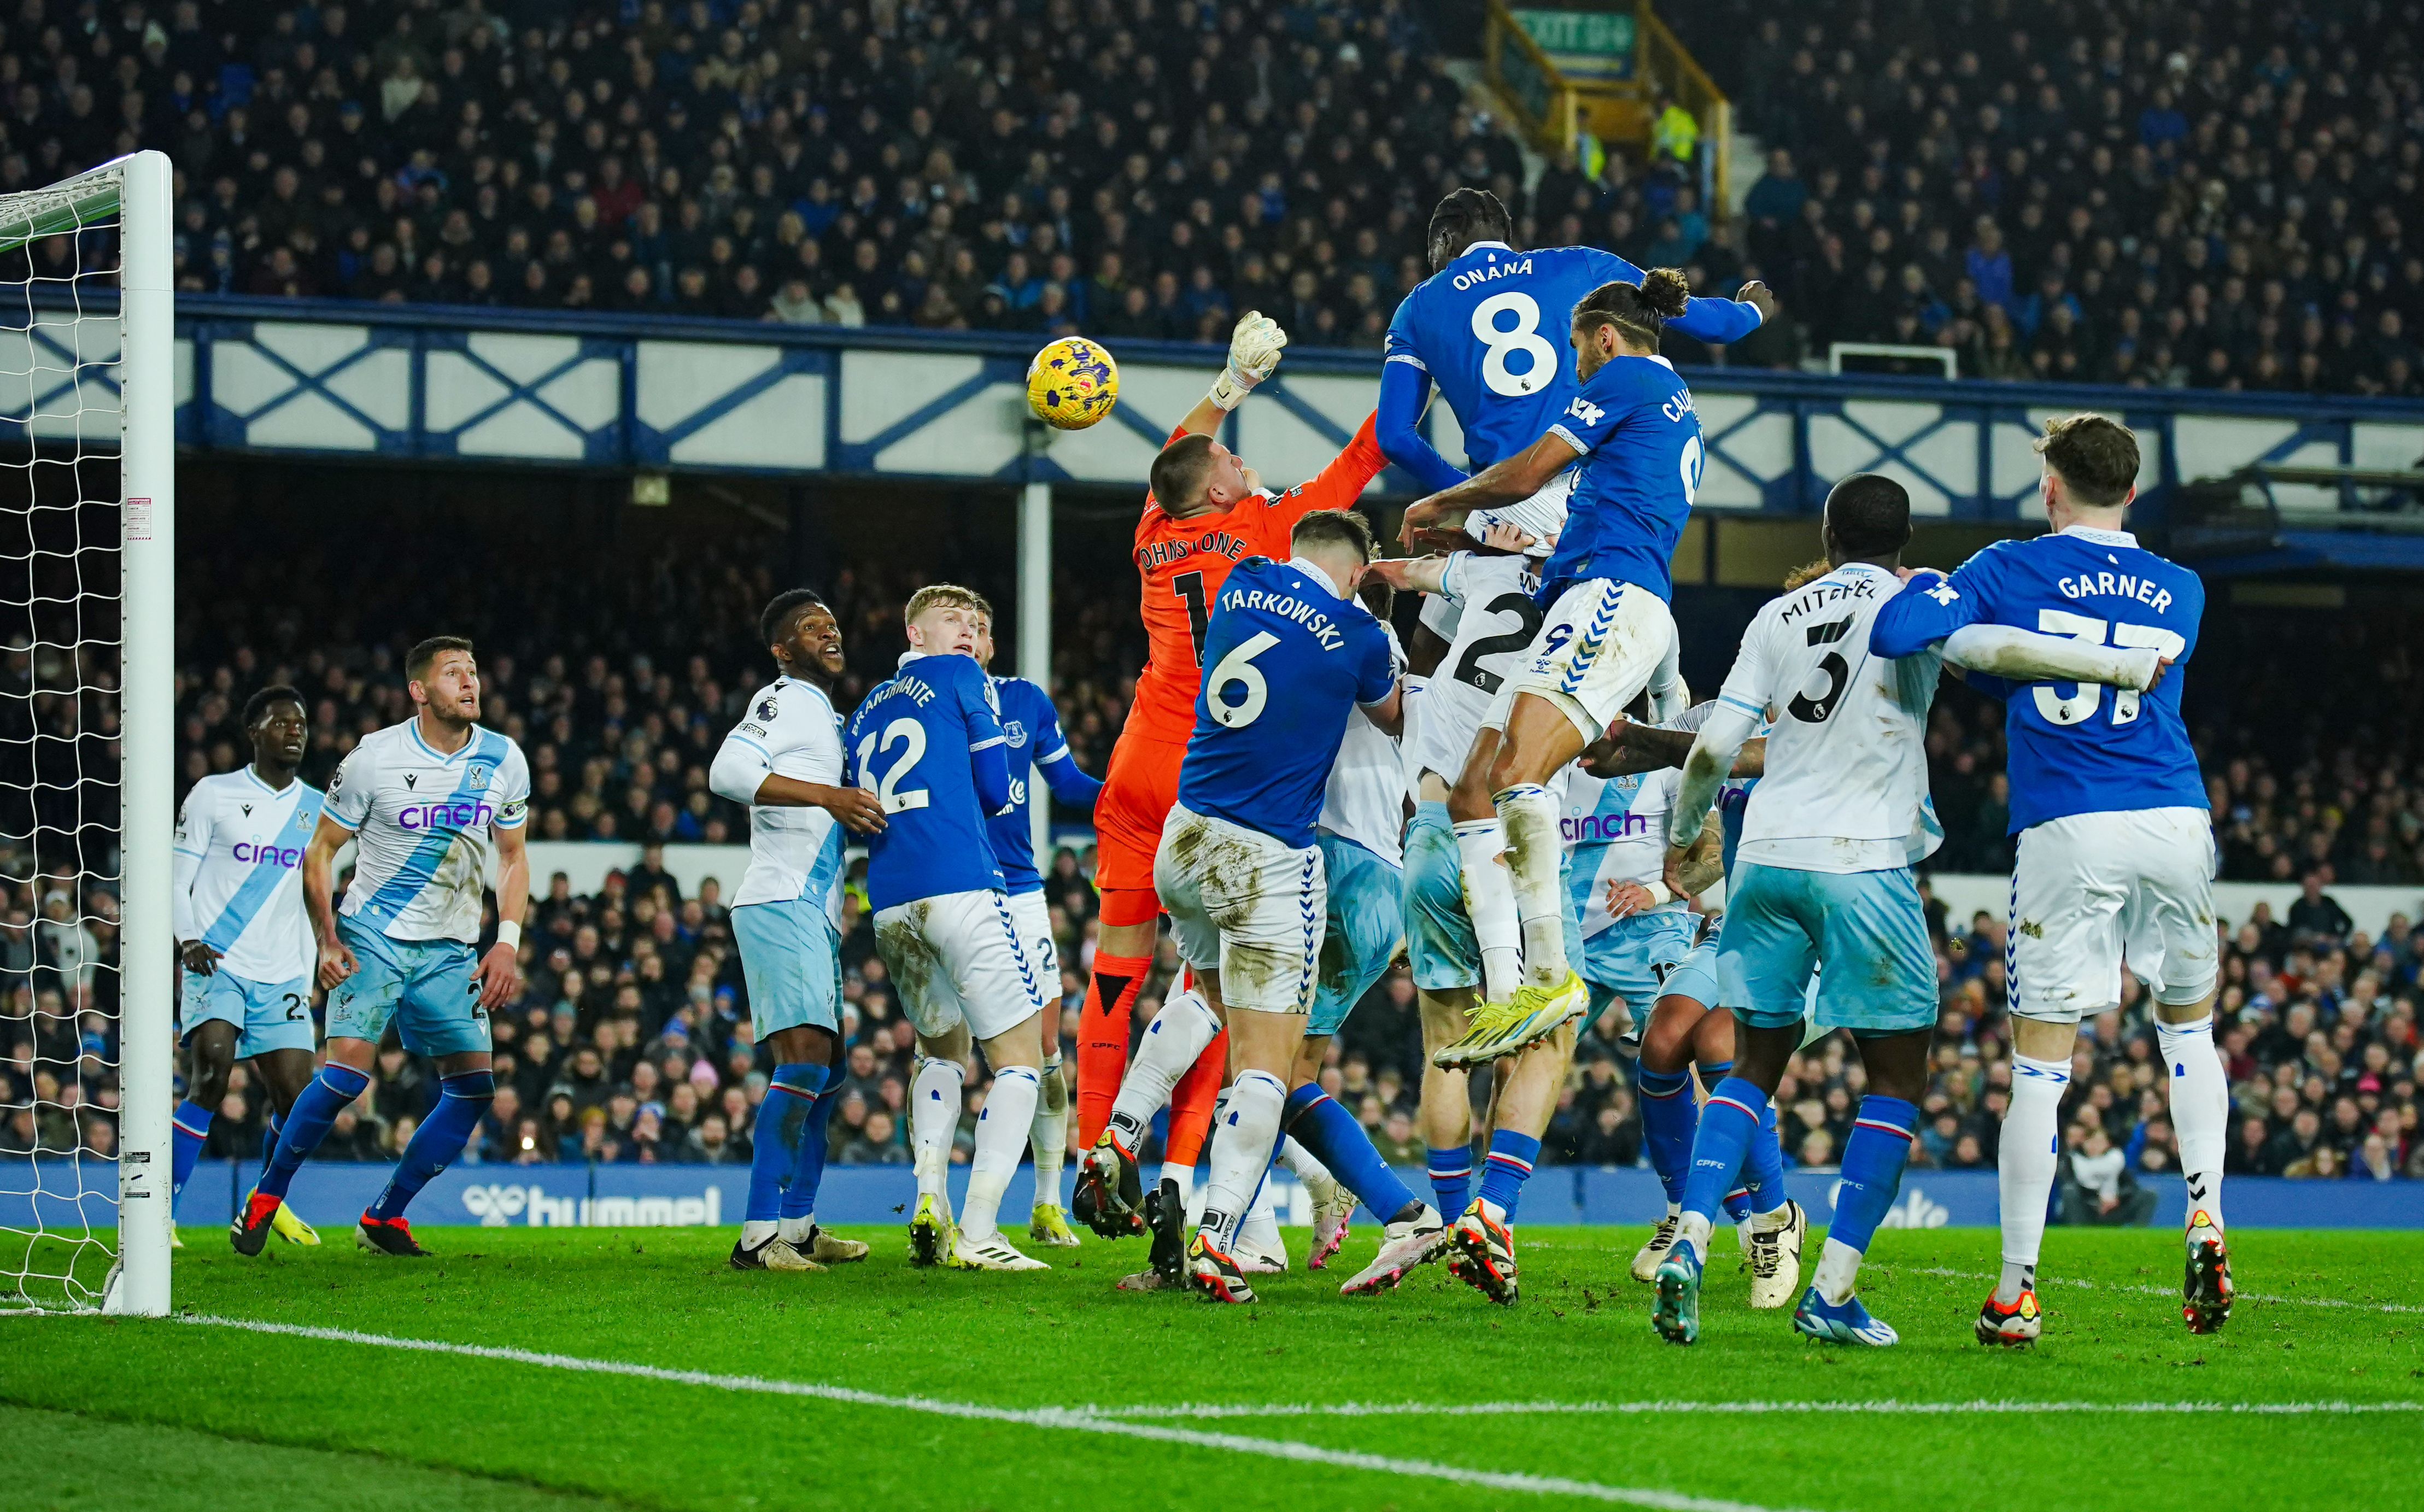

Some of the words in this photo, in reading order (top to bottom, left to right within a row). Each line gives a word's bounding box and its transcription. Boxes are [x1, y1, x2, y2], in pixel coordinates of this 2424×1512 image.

[1452, 259, 1532, 291] ONANA
[1471, 291, 1558, 397] 8
[2058, 572, 2173, 614] GARNER
[1172, 570, 1209, 669] 1
[1222, 589, 1345, 652] TARKOWSKI
[1541, 624, 1573, 656] 9
[1207, 630, 1281, 728] 6
[1788, 610, 1857, 723] 3
[856, 717, 929, 814] 12
[399, 799, 491, 830] cinch
[1560, 807, 1647, 841] cinch
[1092, 1042, 1120, 1051] CPFC
[1696, 1159, 1725, 1169] CPFC
[528, 1185, 721, 1227] hummel
